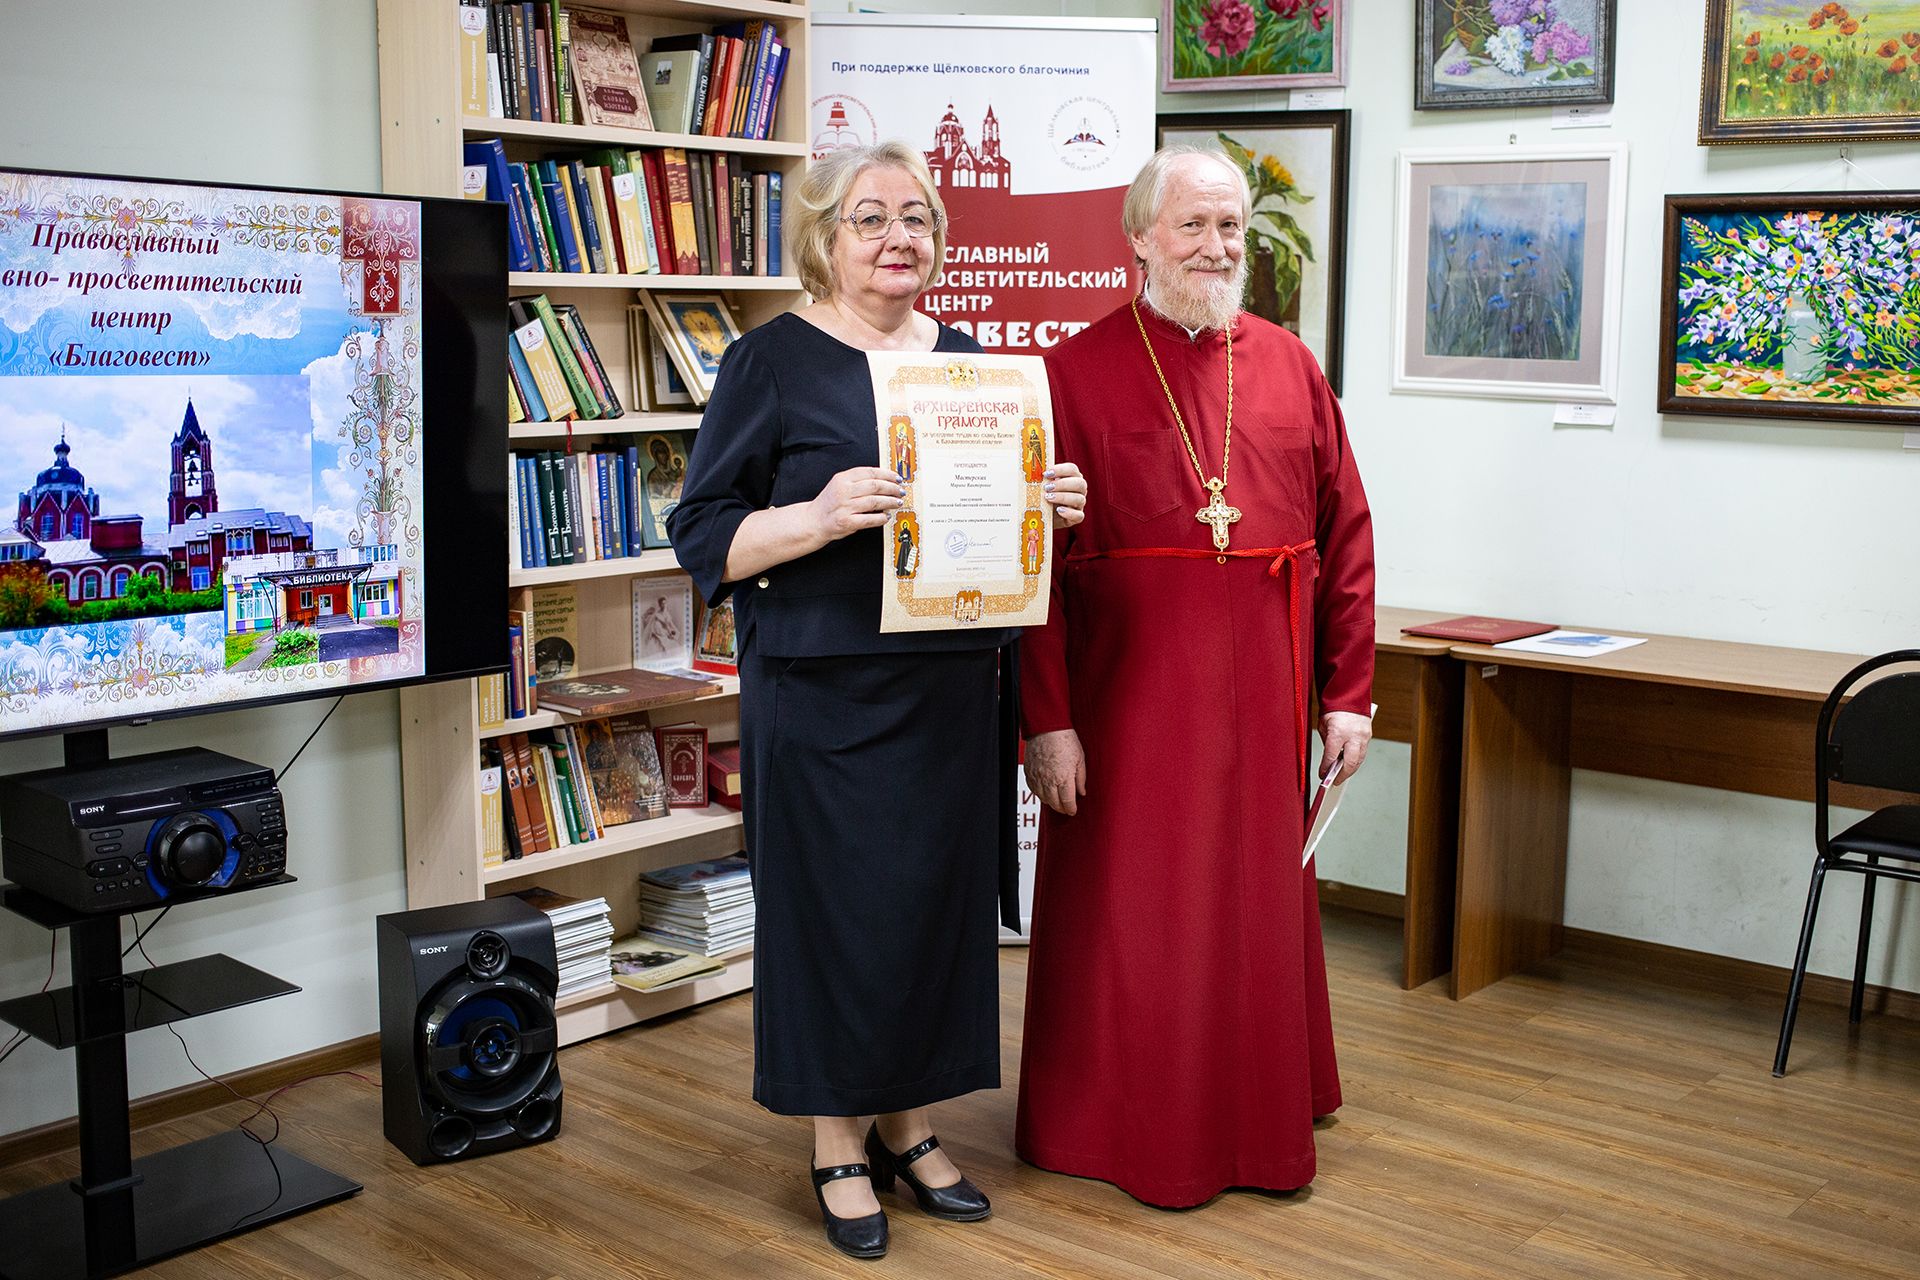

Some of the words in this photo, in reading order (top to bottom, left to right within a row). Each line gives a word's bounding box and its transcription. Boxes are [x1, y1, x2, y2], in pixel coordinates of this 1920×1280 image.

[831, 61, 856, 74] При
[859, 63, 929, 75] поддержке
[932, 62, 1015, 76] Щёлковского
[1019, 63, 1090, 76] благочиния
[31, 222, 220, 257] Православный
[67, 271, 303, 296] просветительский
[924, 294, 993, 315] ЦЕНТР
[90, 306, 172, 335] центр
[48, 343, 211, 368] «Благовест»
[913, 399, 1019, 415] АРХИЕРЕЙСКАЯ
[937, 415, 998, 430] ГРАМОТА
[293, 571, 354, 586] БИБЛИОТЕКА
[79, 805, 105, 815] SONY
[419, 945, 448, 956] SONY
